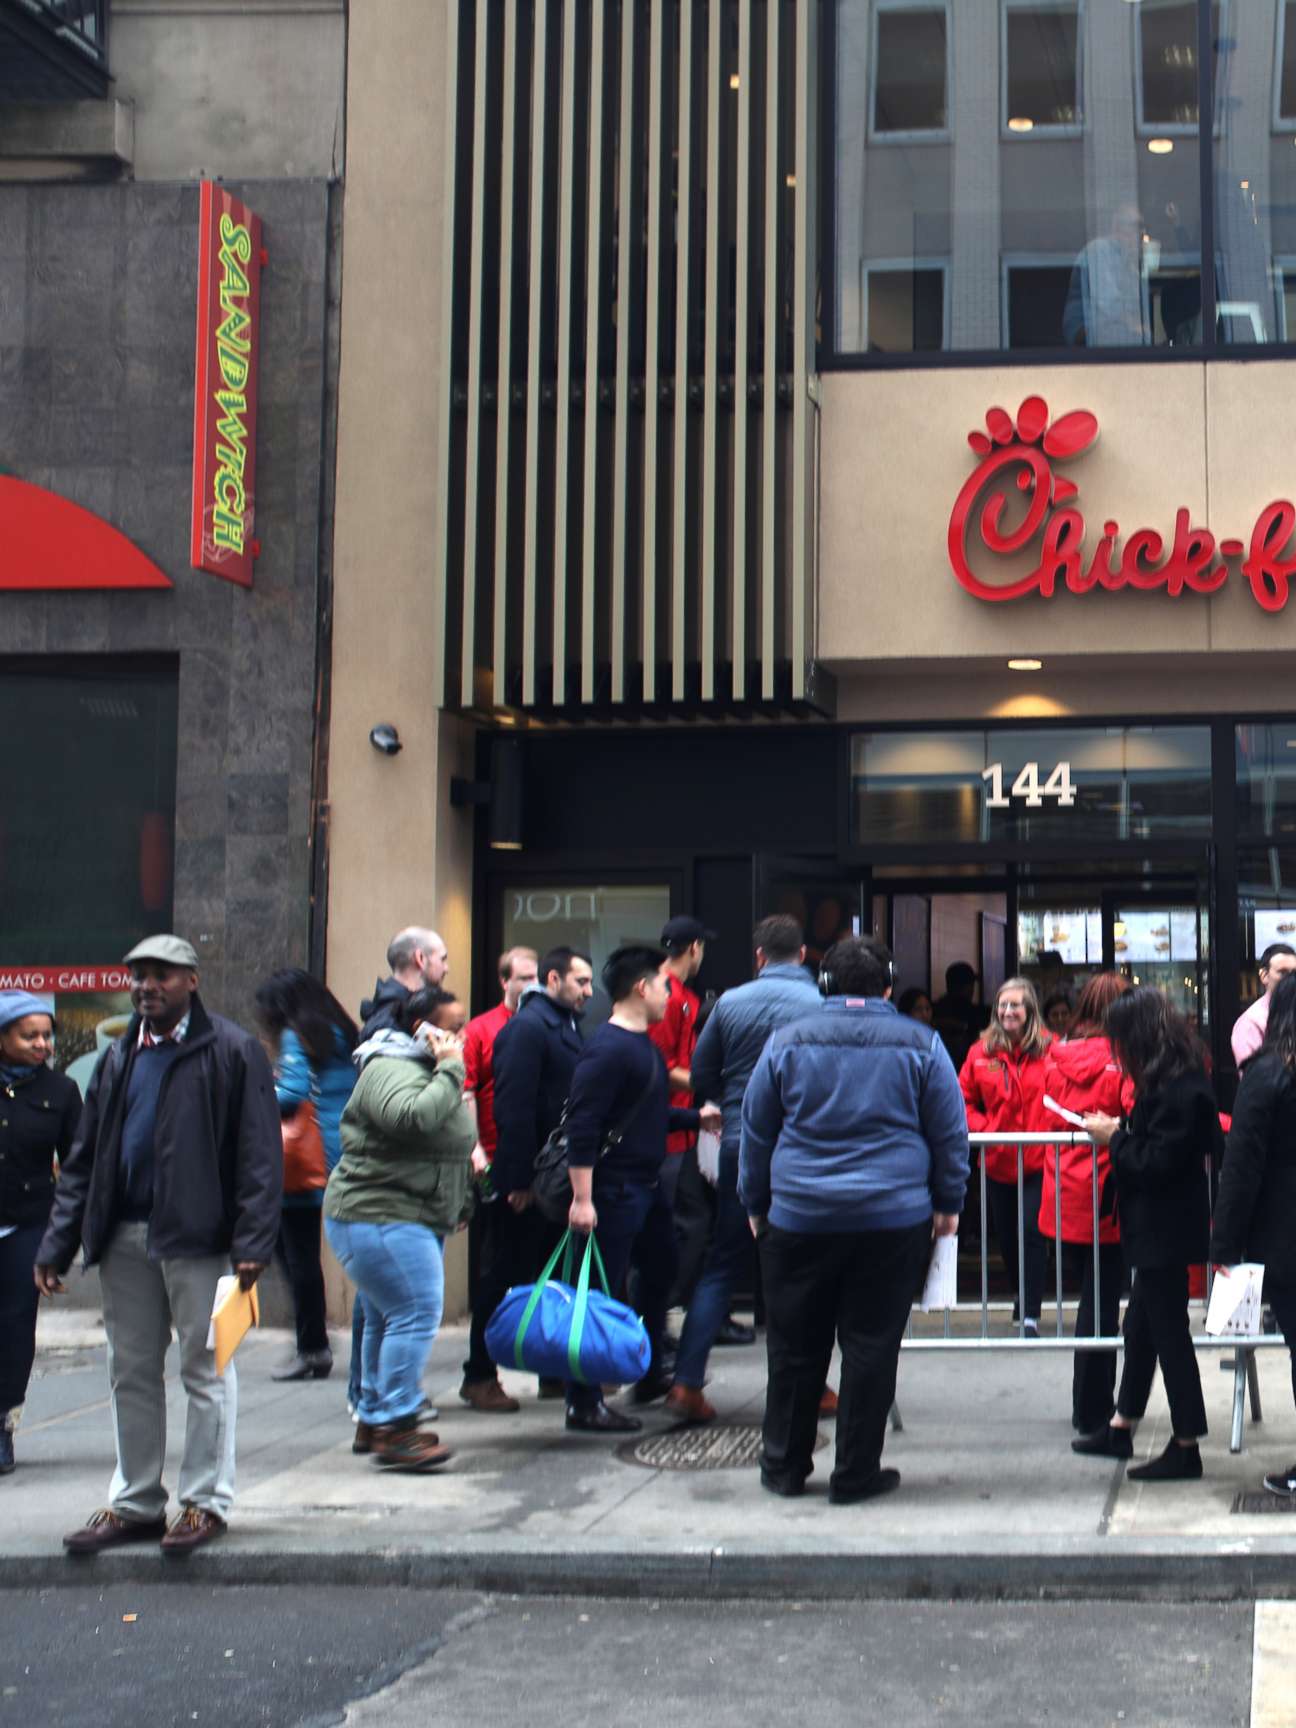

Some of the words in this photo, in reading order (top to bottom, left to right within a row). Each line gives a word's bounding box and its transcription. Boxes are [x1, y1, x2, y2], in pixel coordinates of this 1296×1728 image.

[213, 213, 250, 555] SANDWICH
[981, 761, 1077, 807] 144
[58, 972, 96, 989] CAFE
